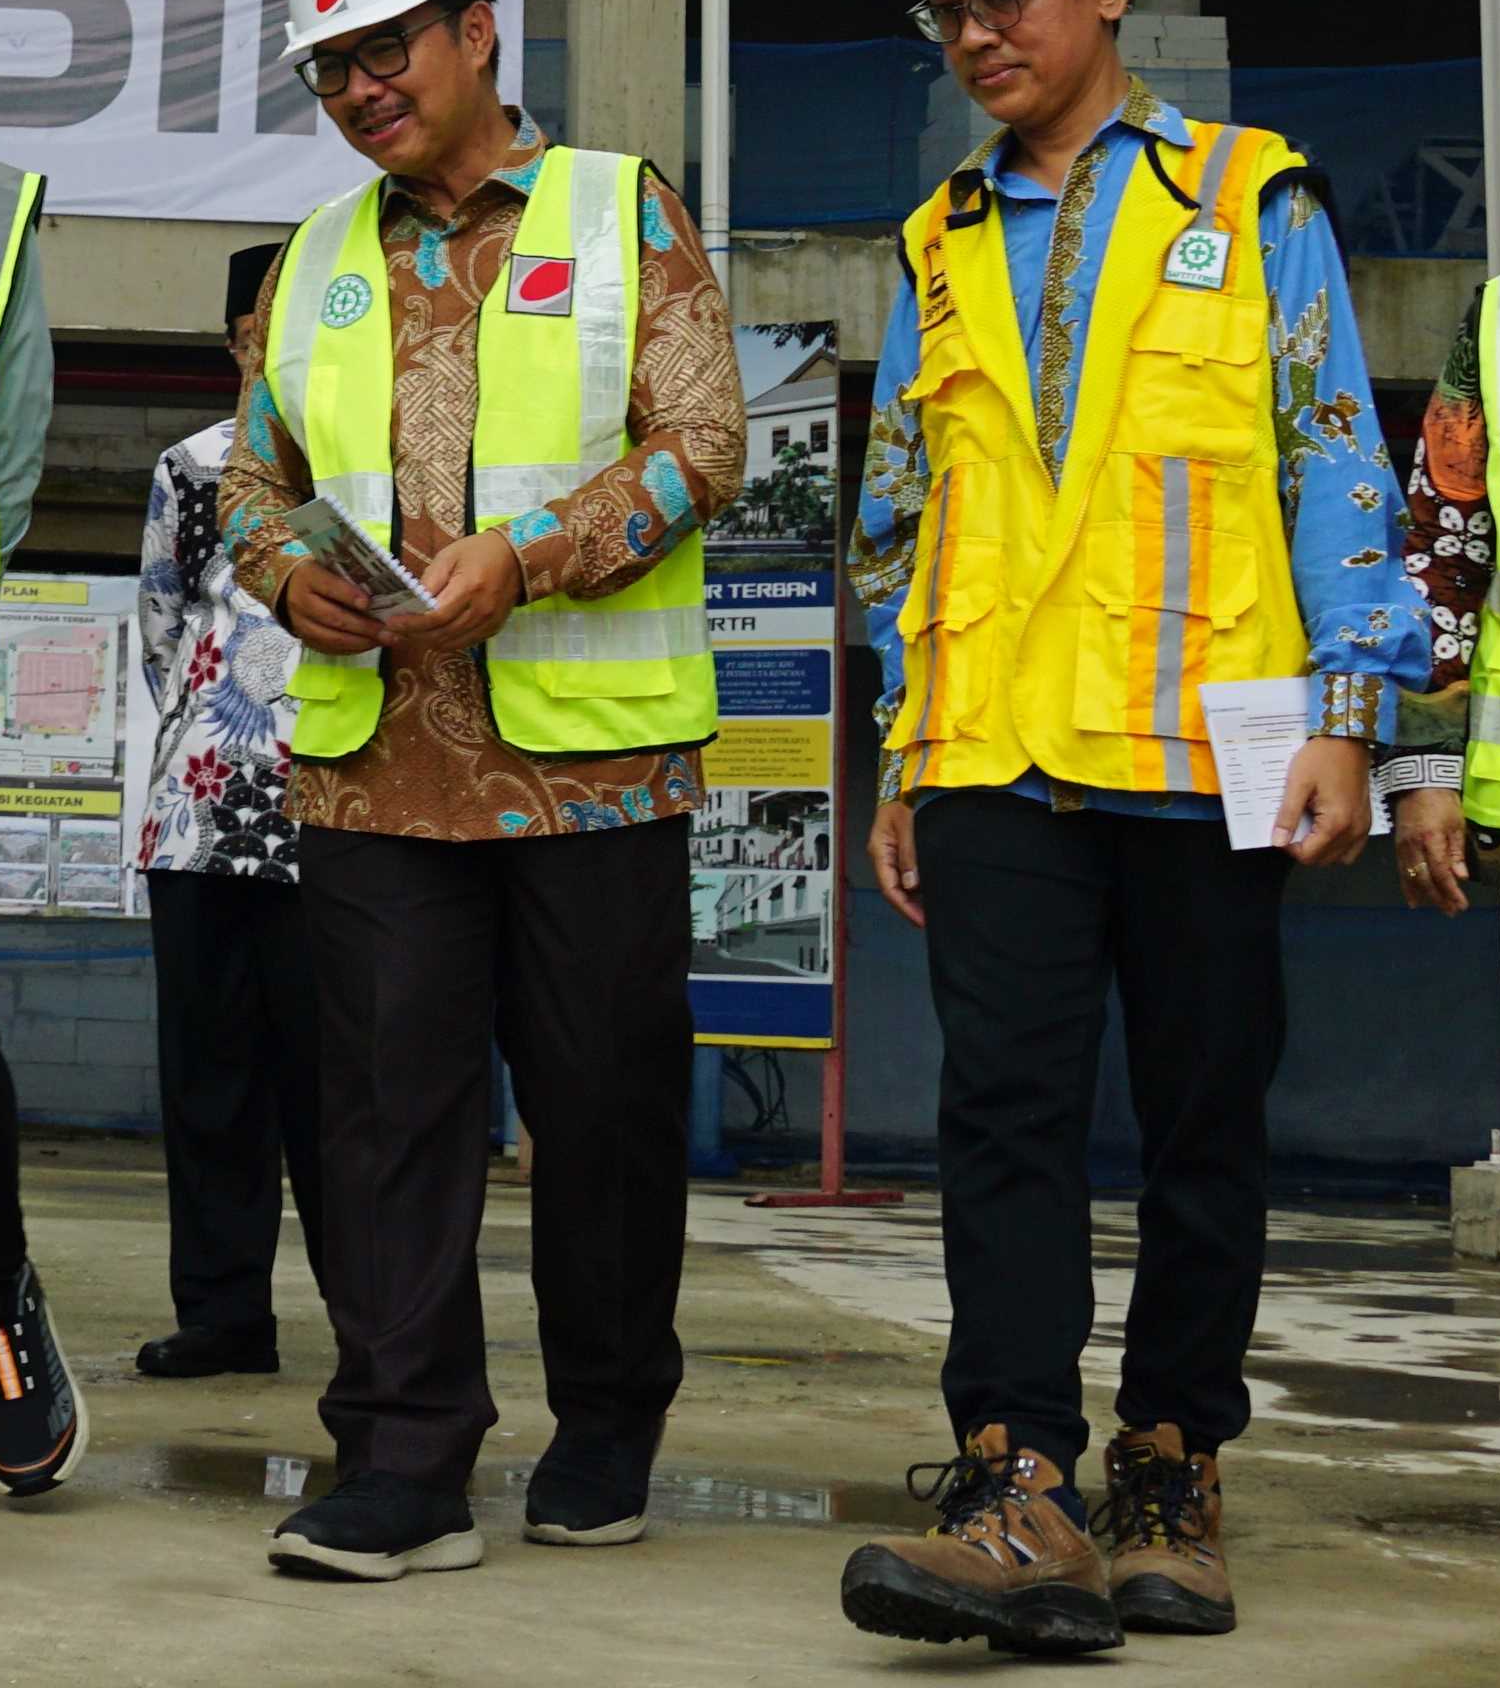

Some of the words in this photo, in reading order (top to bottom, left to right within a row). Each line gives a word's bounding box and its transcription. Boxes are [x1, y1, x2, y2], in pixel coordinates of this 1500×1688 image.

[3, 586, 39, 597] PLAN
[727, 581, 818, 600] TERBAN
[15, 795, 84, 807] KEGIATAN
